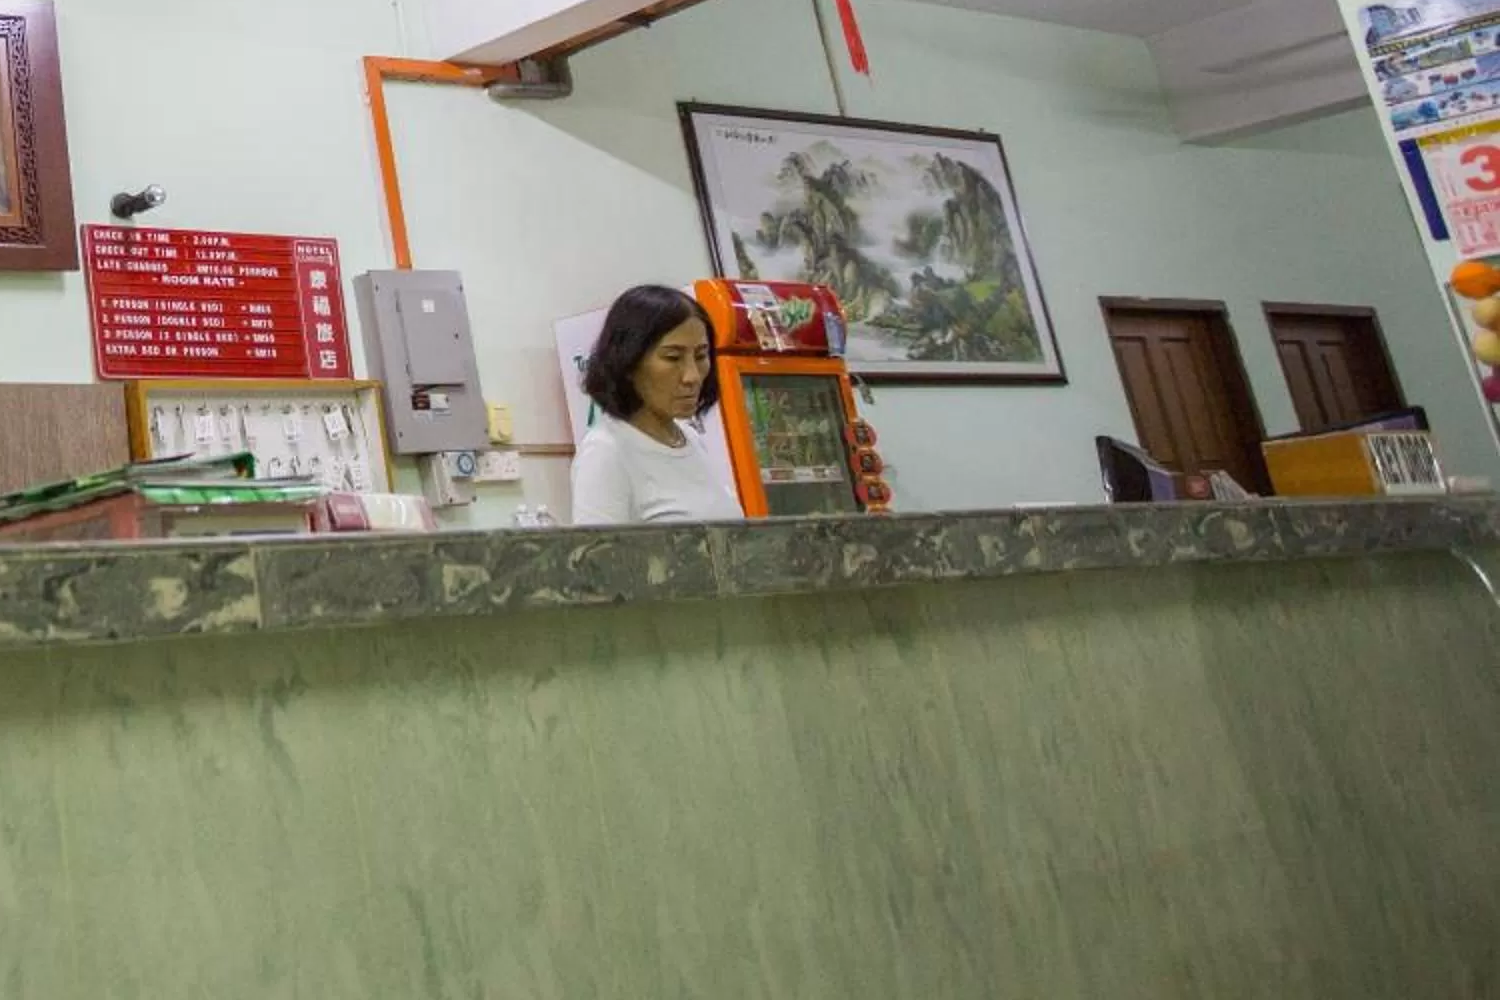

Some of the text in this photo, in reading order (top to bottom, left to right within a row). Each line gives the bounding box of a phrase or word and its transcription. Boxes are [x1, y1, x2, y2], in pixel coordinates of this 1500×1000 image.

[94, 230, 124, 241] CHECK
[147, 233, 170, 243] TIME
[95, 245, 125, 255] CHECK
[130, 247, 149, 257] OUT
[154, 247, 177, 258] TIME
[97, 260, 121, 271] LATE
[162, 274, 235, 287] ROOM RATE
[112, 299, 149, 310] PERSON
[113, 314, 150, 326] PERSON
[115, 329, 152, 341] PERSON
[105, 343, 137, 355] EXTRA
[142, 345, 160, 356] BED
[183, 347, 219, 358] PERSON
